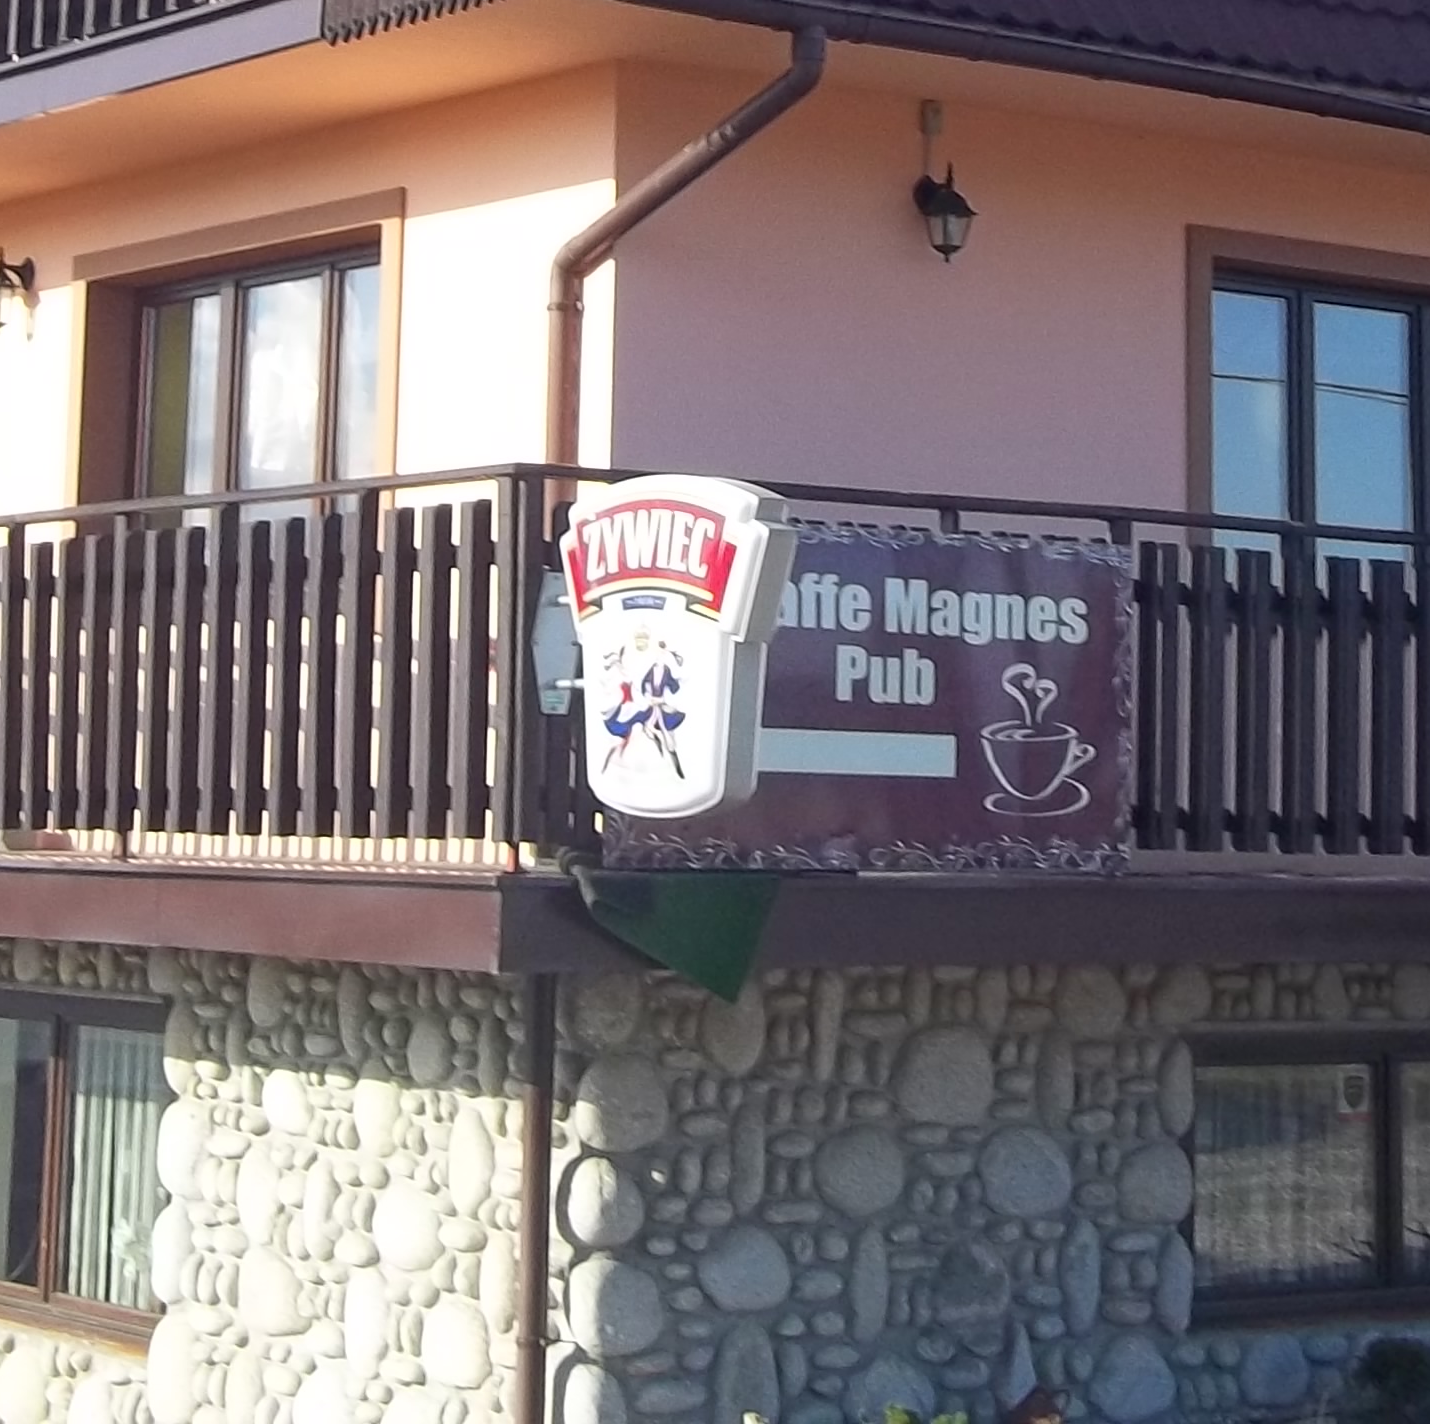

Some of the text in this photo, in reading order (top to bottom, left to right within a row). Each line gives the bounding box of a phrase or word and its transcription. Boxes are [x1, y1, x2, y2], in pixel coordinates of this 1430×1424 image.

[776, 573, 1089, 645] affe Magnes
[836, 644, 937, 705] Pub
